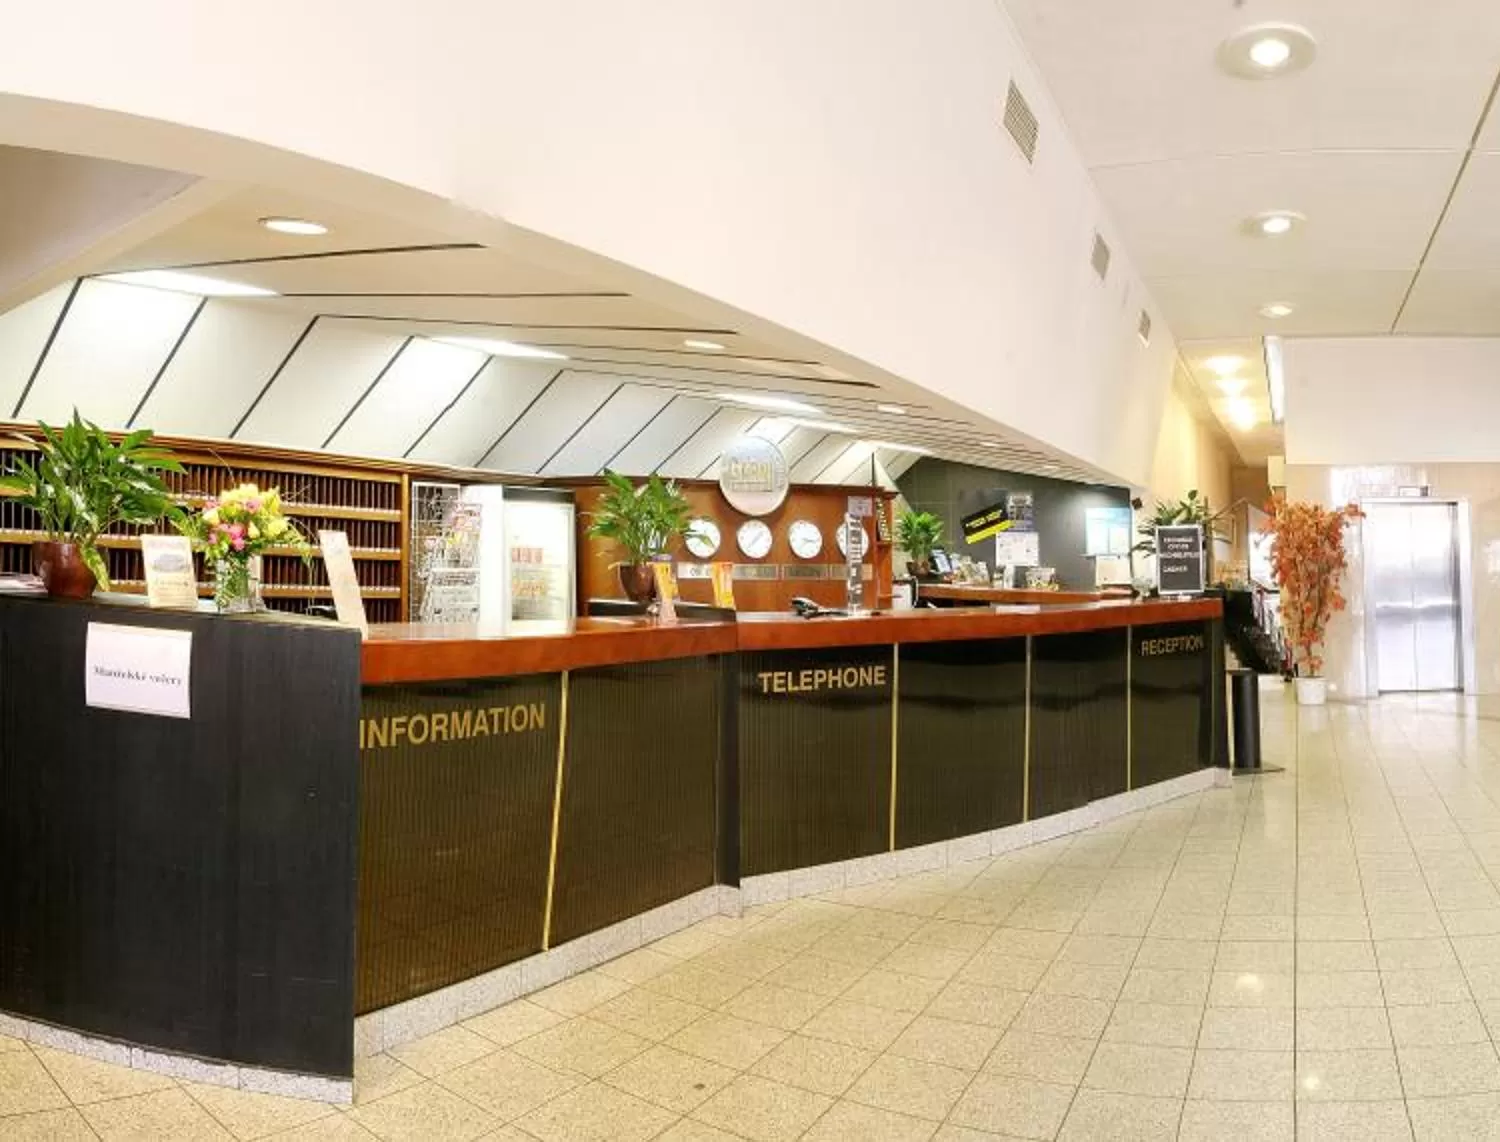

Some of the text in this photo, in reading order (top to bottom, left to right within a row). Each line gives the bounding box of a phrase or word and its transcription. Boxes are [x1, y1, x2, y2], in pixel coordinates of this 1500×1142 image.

[1141, 635, 1205, 657] RECEPTION
[758, 665, 886, 693] TELEPHONE
[359, 703, 545, 749] INFORMATION
